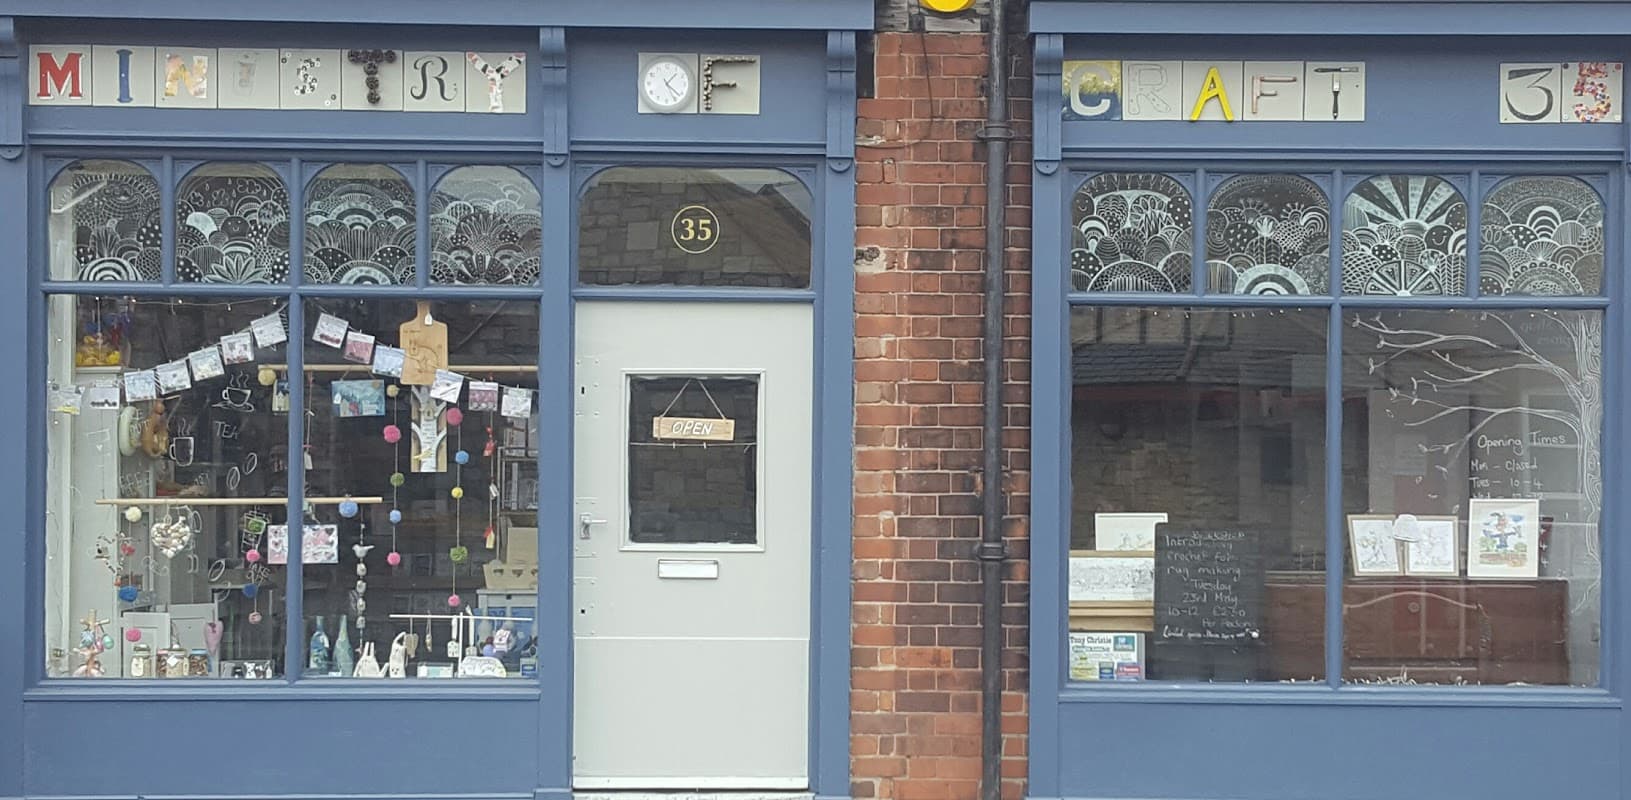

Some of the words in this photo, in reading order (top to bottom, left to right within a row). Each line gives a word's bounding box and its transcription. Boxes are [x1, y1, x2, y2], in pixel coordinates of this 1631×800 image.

[1068, 63, 1360, 122] CRAFT
[1504, 62, 1613, 123] 35
[679, 217, 713, 241] 35
[213, 420, 240, 439] TEA
[671, 421, 713, 436] OPEN
[1477, 434, 1523, 456] Opening
[1528, 430, 1566, 446] Times
[1469, 476, 1490, 488] Tues
[1191, 578, 1232, 595] Tuesday
[1215, 592, 1238, 606] May
